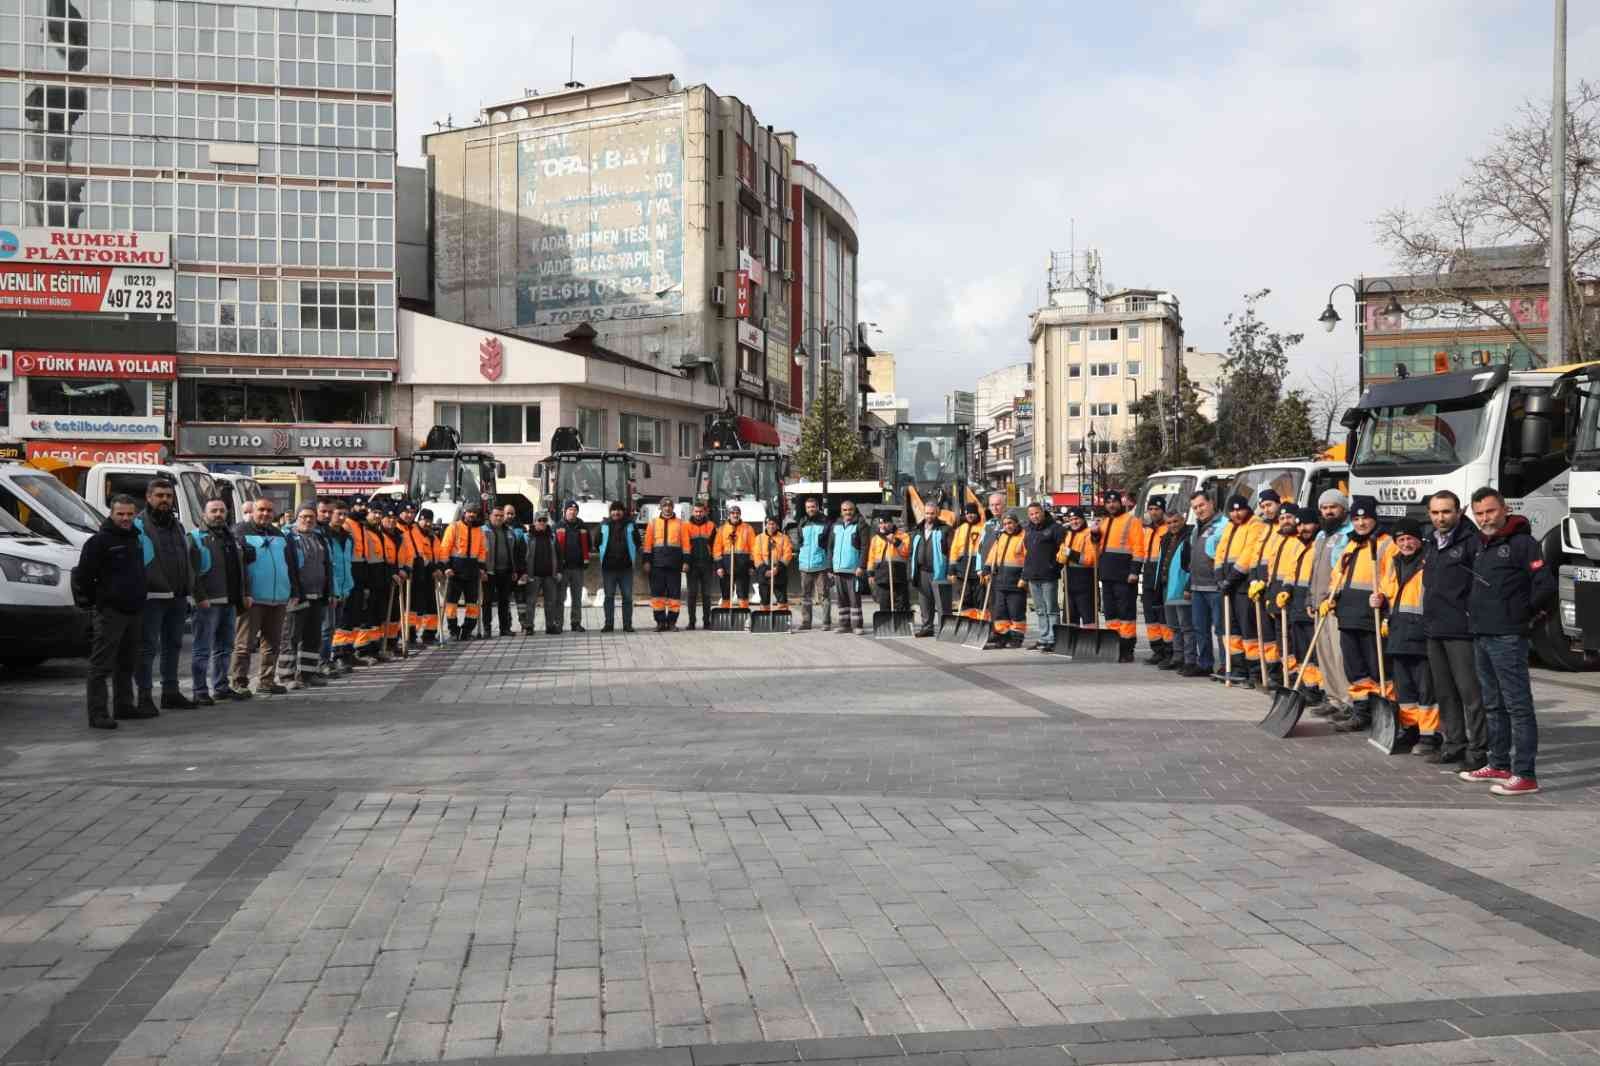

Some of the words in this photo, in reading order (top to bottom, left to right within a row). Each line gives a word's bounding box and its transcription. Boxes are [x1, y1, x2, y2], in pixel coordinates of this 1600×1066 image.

[51, 232, 138, 248] RUMELİ
[576, 229, 619, 249] HEMEN
[623, 223, 667, 243] TESLM
[25, 247, 165, 264] PLATFORMU
[50, 269, 100, 294] EĞİTİMİ
[124, 274, 156, 287] (0212)
[107, 289, 131, 308] 497
[136, 290, 152, 309] 23
[156, 291, 173, 310] 23
[738, 273, 747, 314] THY
[37, 355, 74, 371] TÜRK
[78, 359, 114, 372] HAVA
[118, 360, 173, 373] YOLLARI
[54, 420, 159, 433] tatilbudur.com
[208, 435, 262, 446] BUTRO
[300, 436, 363, 448] BURGER
[312, 458, 340, 470] ALİ
[1379, 488, 1417, 501] IVECO
